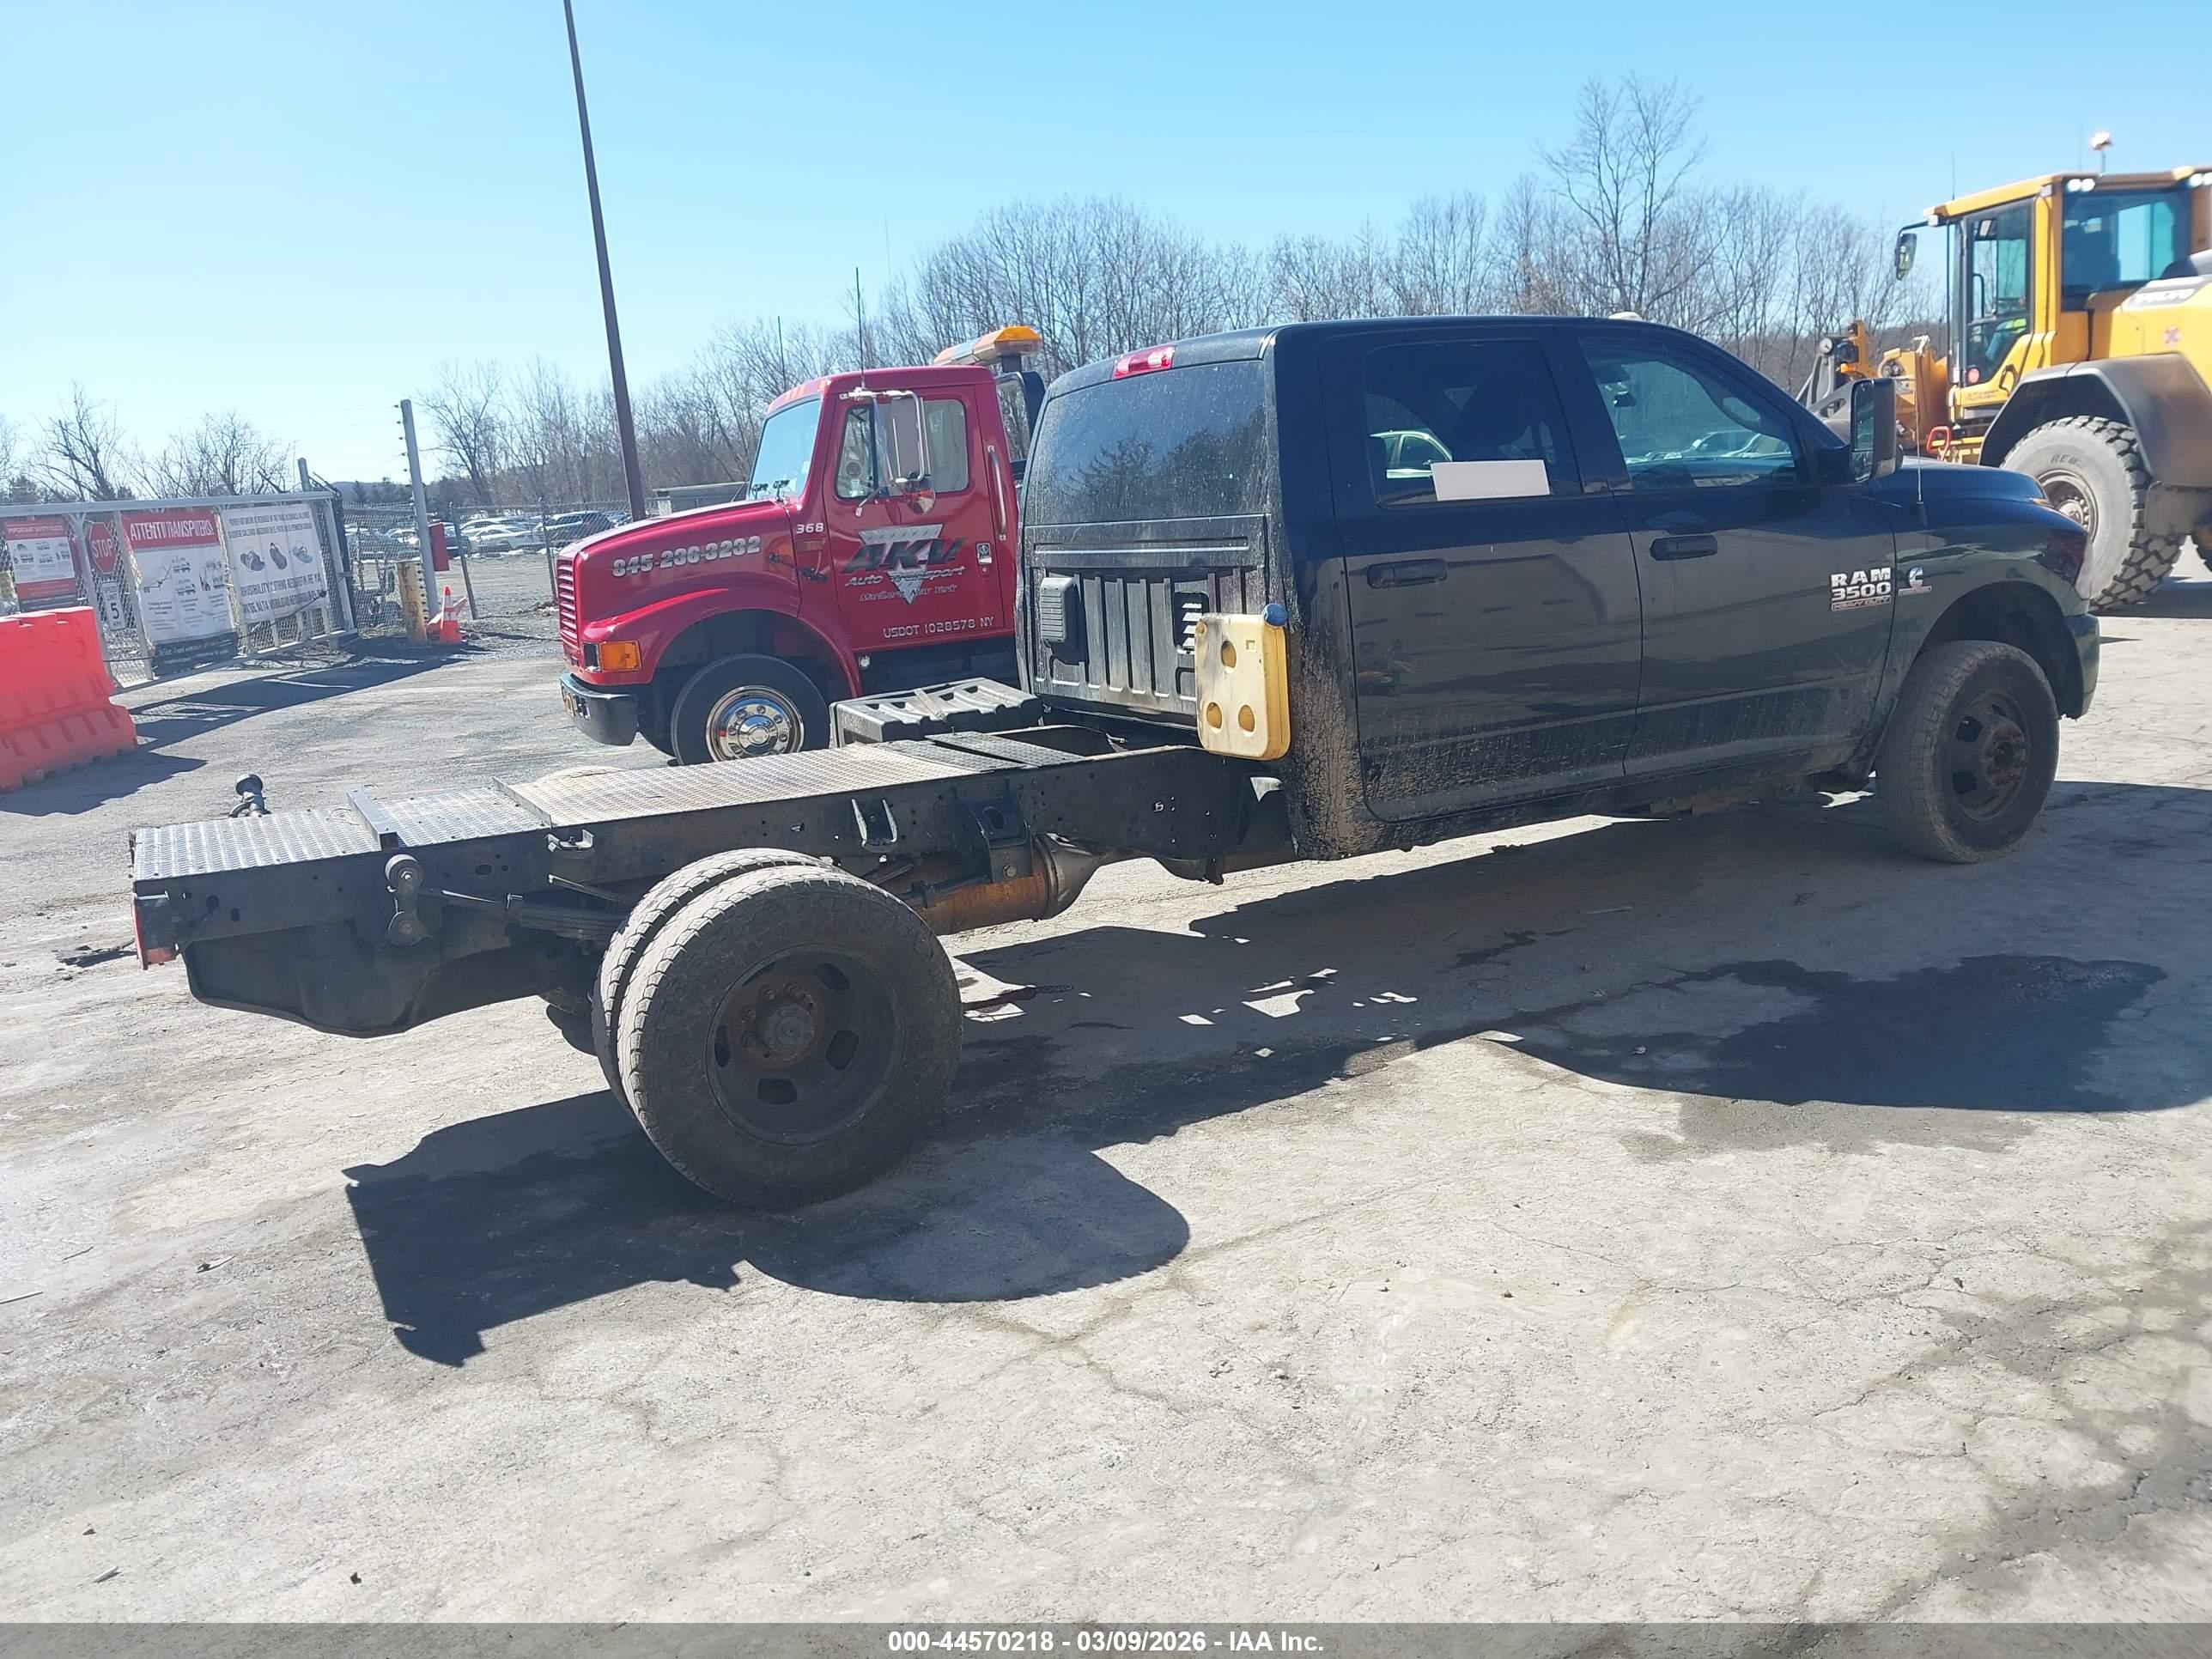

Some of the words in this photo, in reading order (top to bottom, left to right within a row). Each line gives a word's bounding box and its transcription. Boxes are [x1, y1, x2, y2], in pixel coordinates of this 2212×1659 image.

[130, 521, 167, 541] ATTENTI
[796, 522, 824, 534] 368
[92, 538, 113, 558] STOP
[612, 535, 762, 578] 845-236-3232
[844, 574, 884, 587] Auto
[891, 565, 967, 582] Transport
[1831, 568, 1891, 587] RAM
[106, 592, 118, 601] LIMIT
[1831, 581, 1892, 602] 3500
[110, 602, 119, 620] 5
[883, 624, 921, 639] USDOT
[924, 618, 975, 635] 1028578
[980, 616, 994, 628] NY
